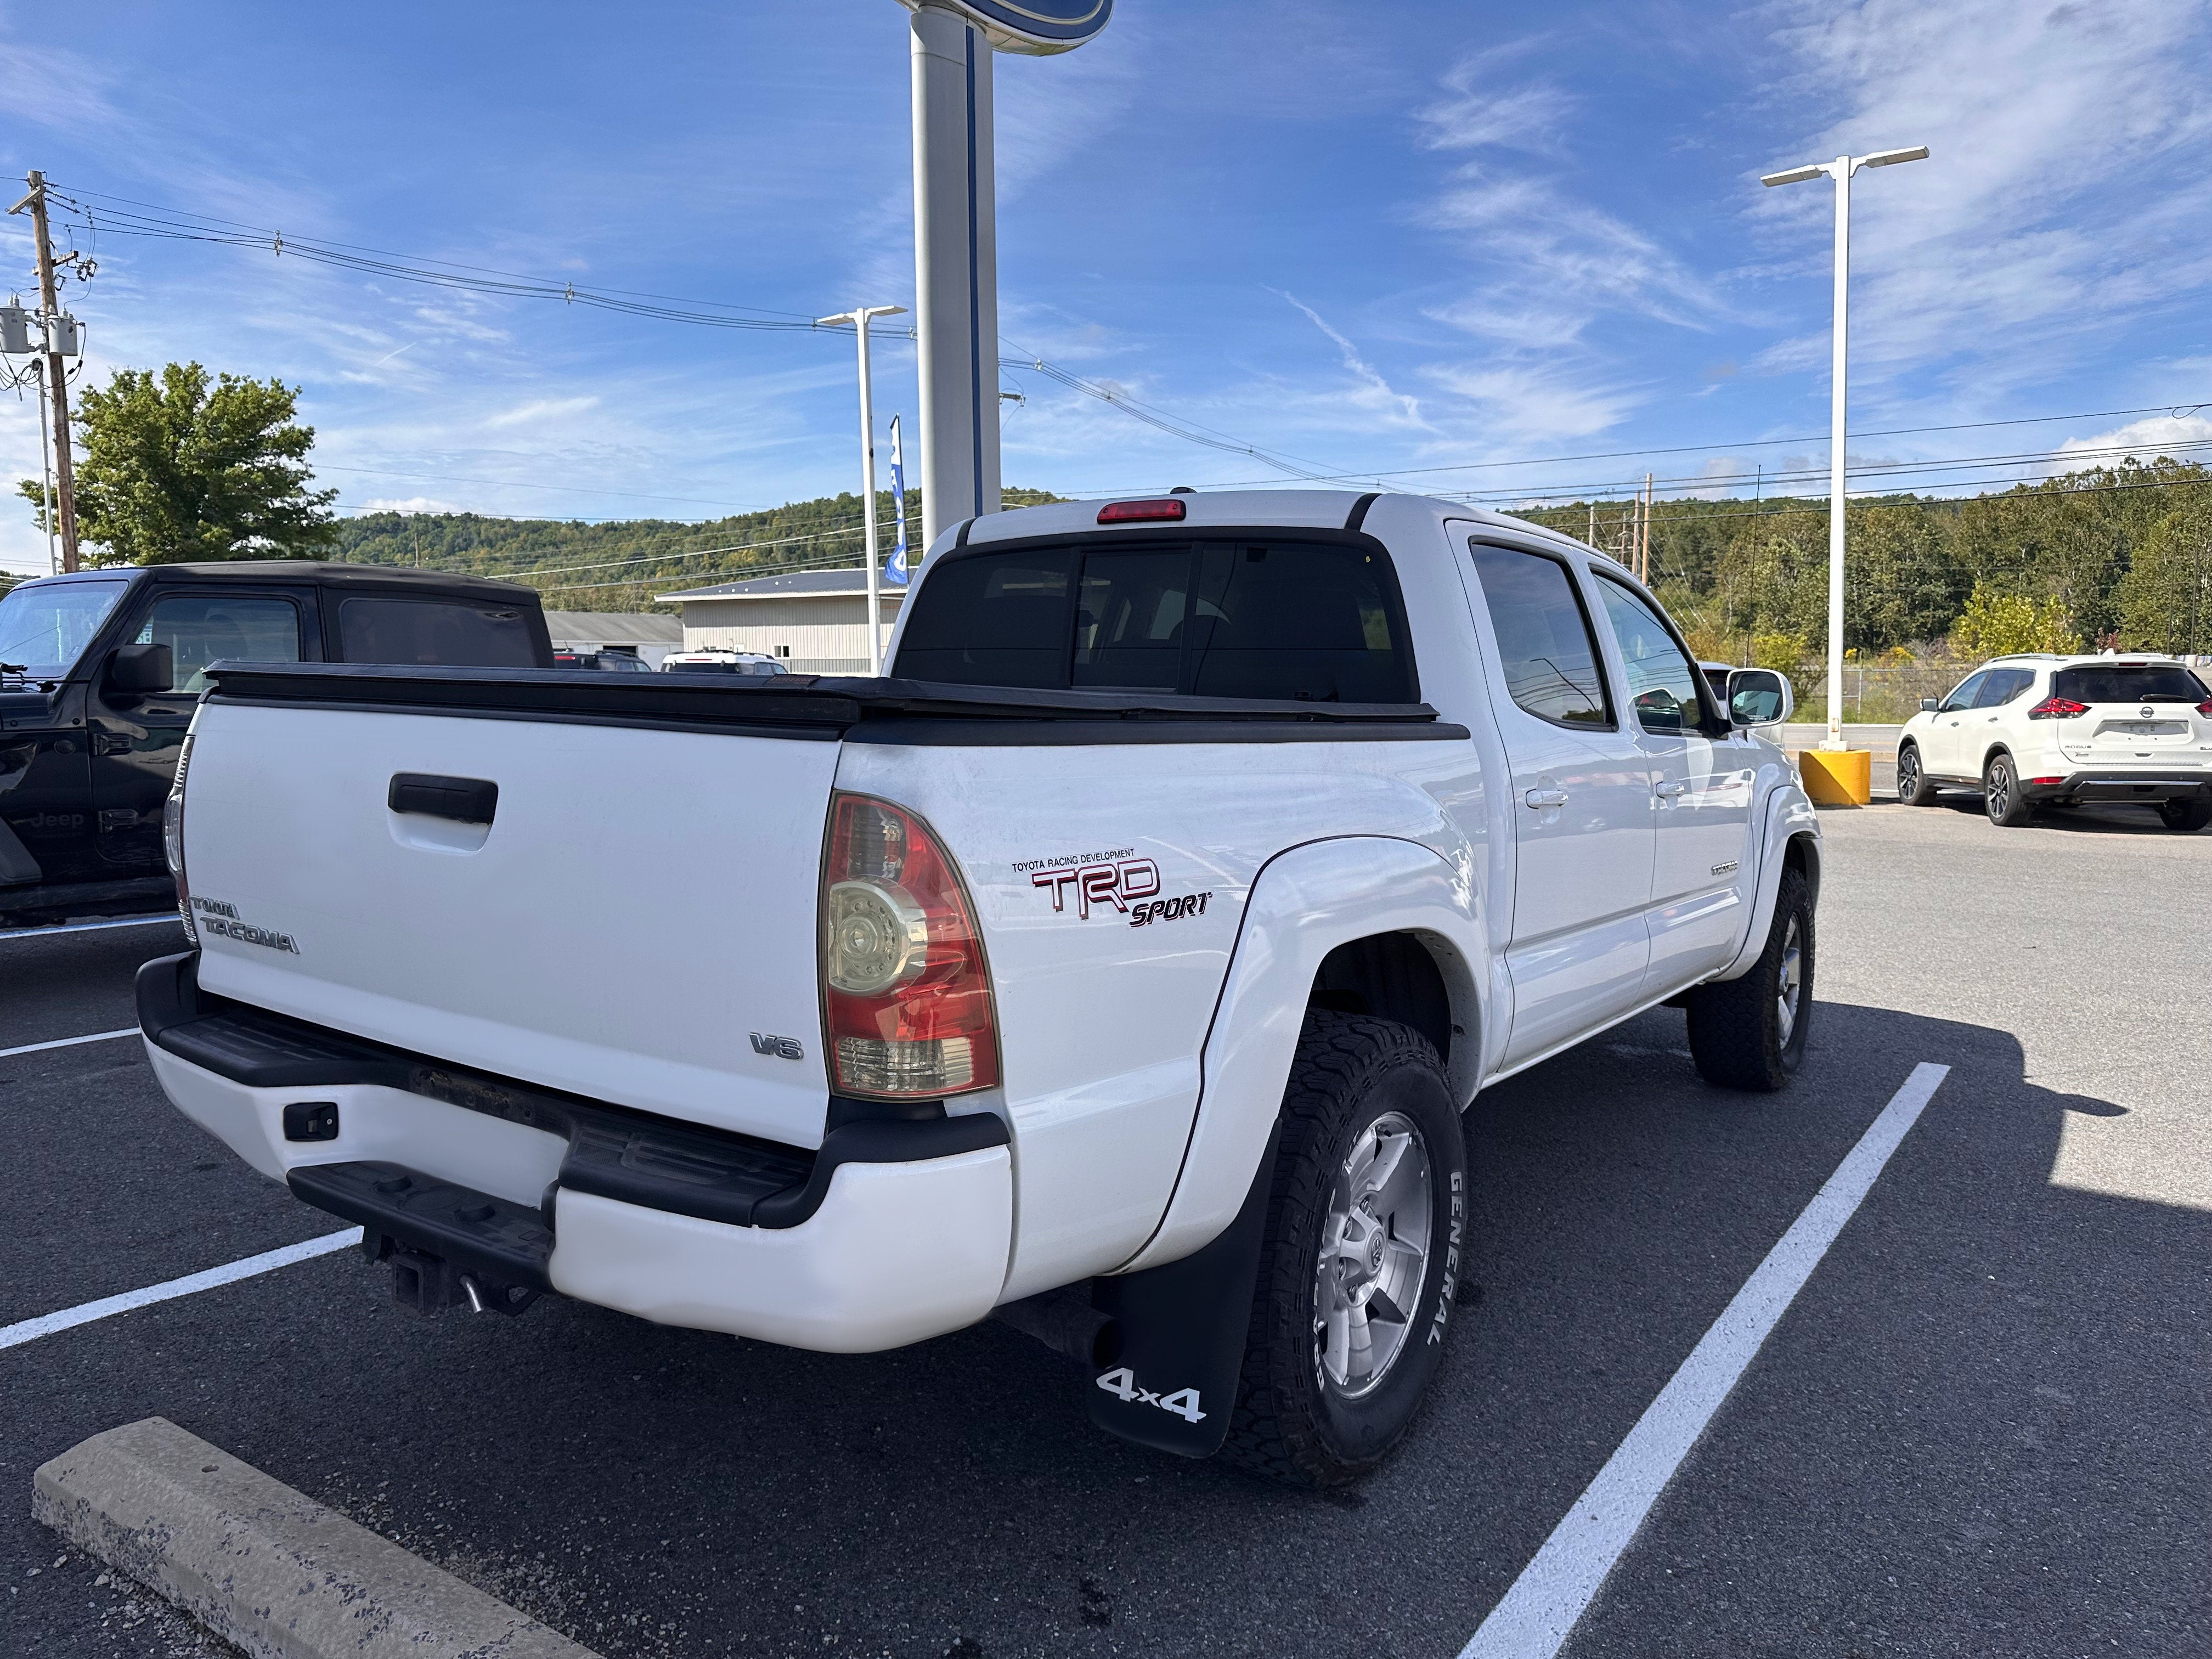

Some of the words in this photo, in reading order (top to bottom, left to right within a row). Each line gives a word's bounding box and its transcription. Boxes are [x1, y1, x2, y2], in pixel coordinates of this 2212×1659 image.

[30, 811, 84, 829] Jeep
[1012, 860, 1045, 872] TOYOTA
[1047, 856, 1079, 868] RACING
[1080, 848, 1135, 864] DEVELOPMENT
[189, 895, 240, 919] TOYOTA
[1031, 858, 1160, 920] TRD
[1128, 891, 1213, 928] SPORT
[200, 915, 300, 955] TACOMA
[749, 1032, 804, 1060] V6
[1426, 1171, 1467, 1347] GENERAL
[1096, 1367, 1207, 1424] 4x4
